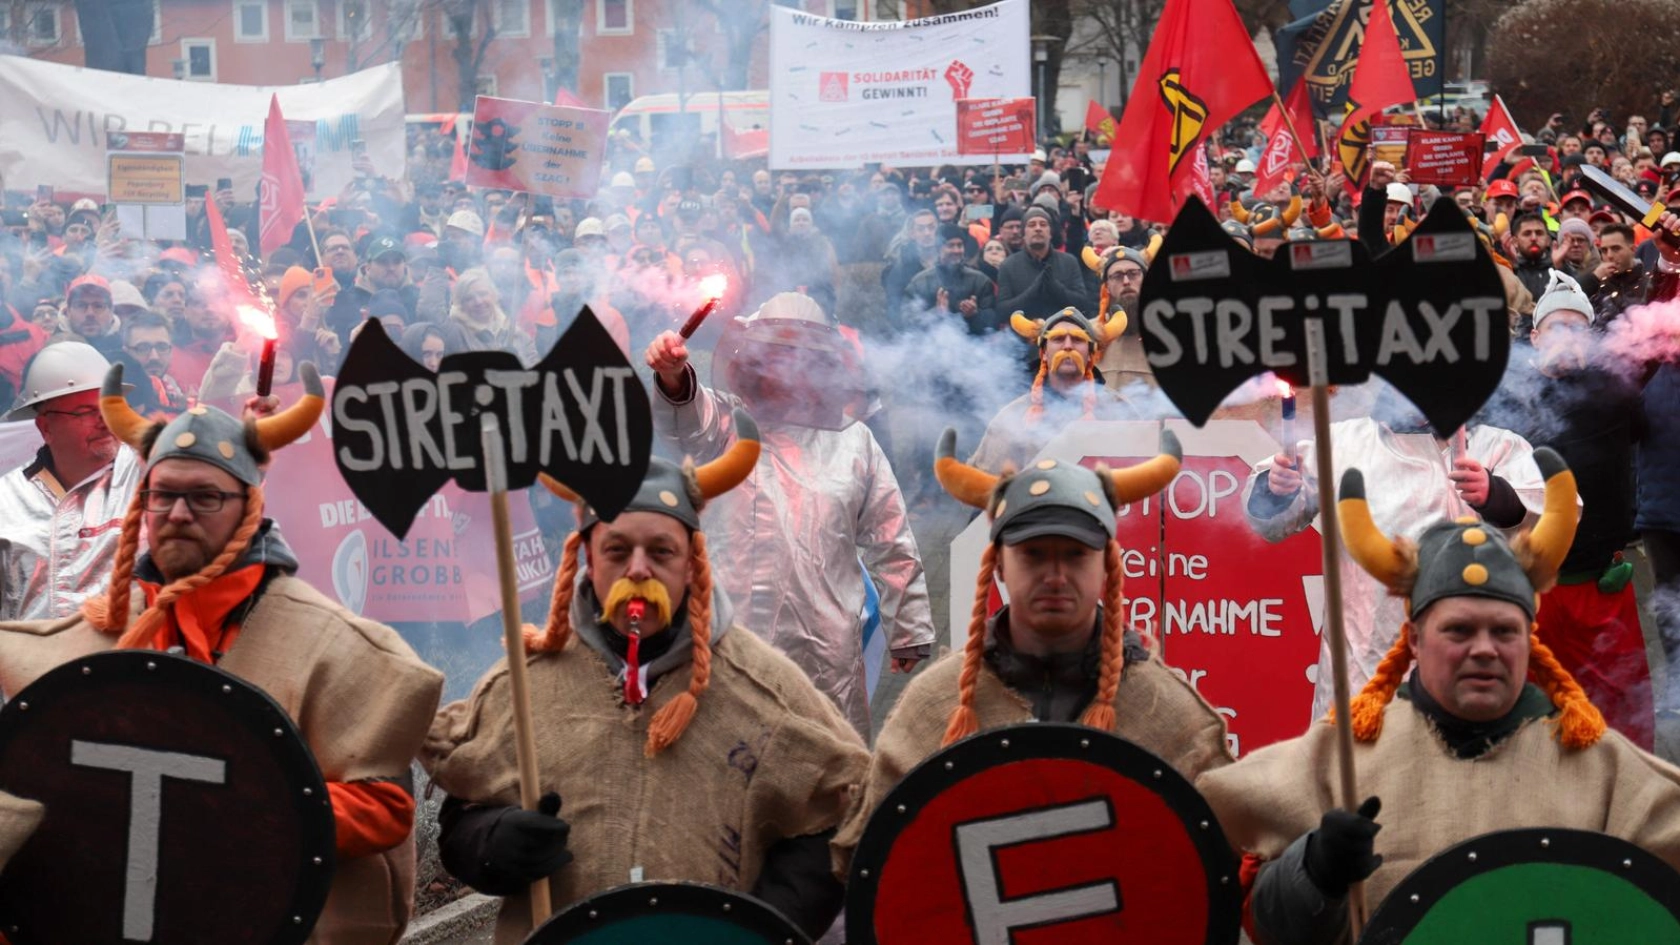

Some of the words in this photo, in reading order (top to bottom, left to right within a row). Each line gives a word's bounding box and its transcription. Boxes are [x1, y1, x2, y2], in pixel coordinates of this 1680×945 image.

[792, 13, 820, 26] Wir
[903, 6, 999, 29] zusammen!
[853, 68, 938, 84] SOLIDARITÄT
[862, 87, 928, 100] GEWINNT!
[538, 117, 572, 128] STOPP
[522, 143, 588, 159] ÜBERNAHME
[1120, 547, 1209, 580] eine
[70, 739, 226, 942] T
